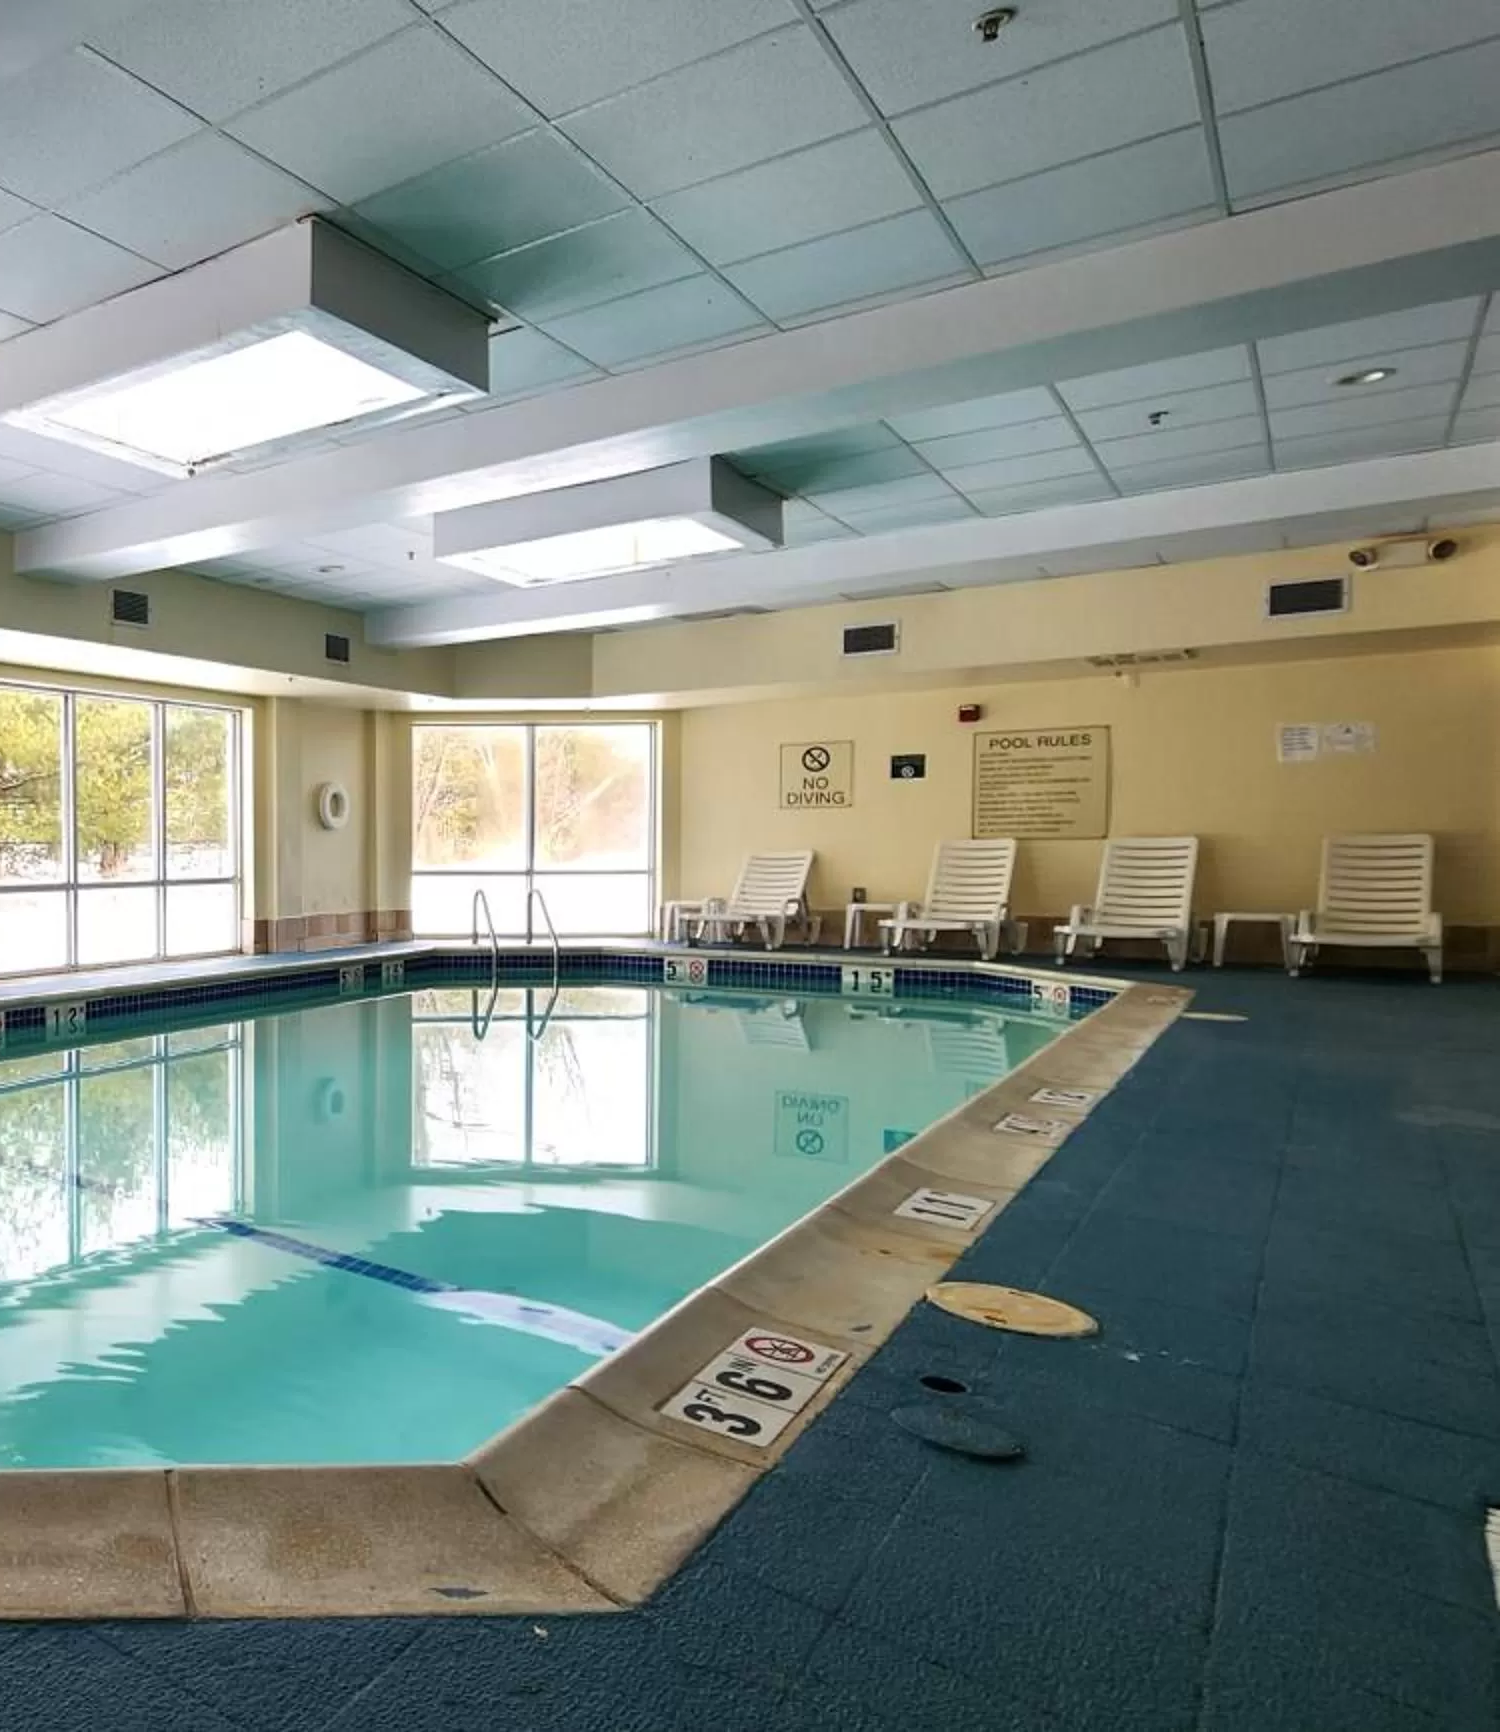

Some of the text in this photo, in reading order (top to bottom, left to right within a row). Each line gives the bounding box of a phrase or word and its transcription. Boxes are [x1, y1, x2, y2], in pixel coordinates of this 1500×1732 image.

[989, 733, 1092, 749] POOL RULES
[802, 777, 829, 789] NO
[787, 792, 845, 804] DIVING
